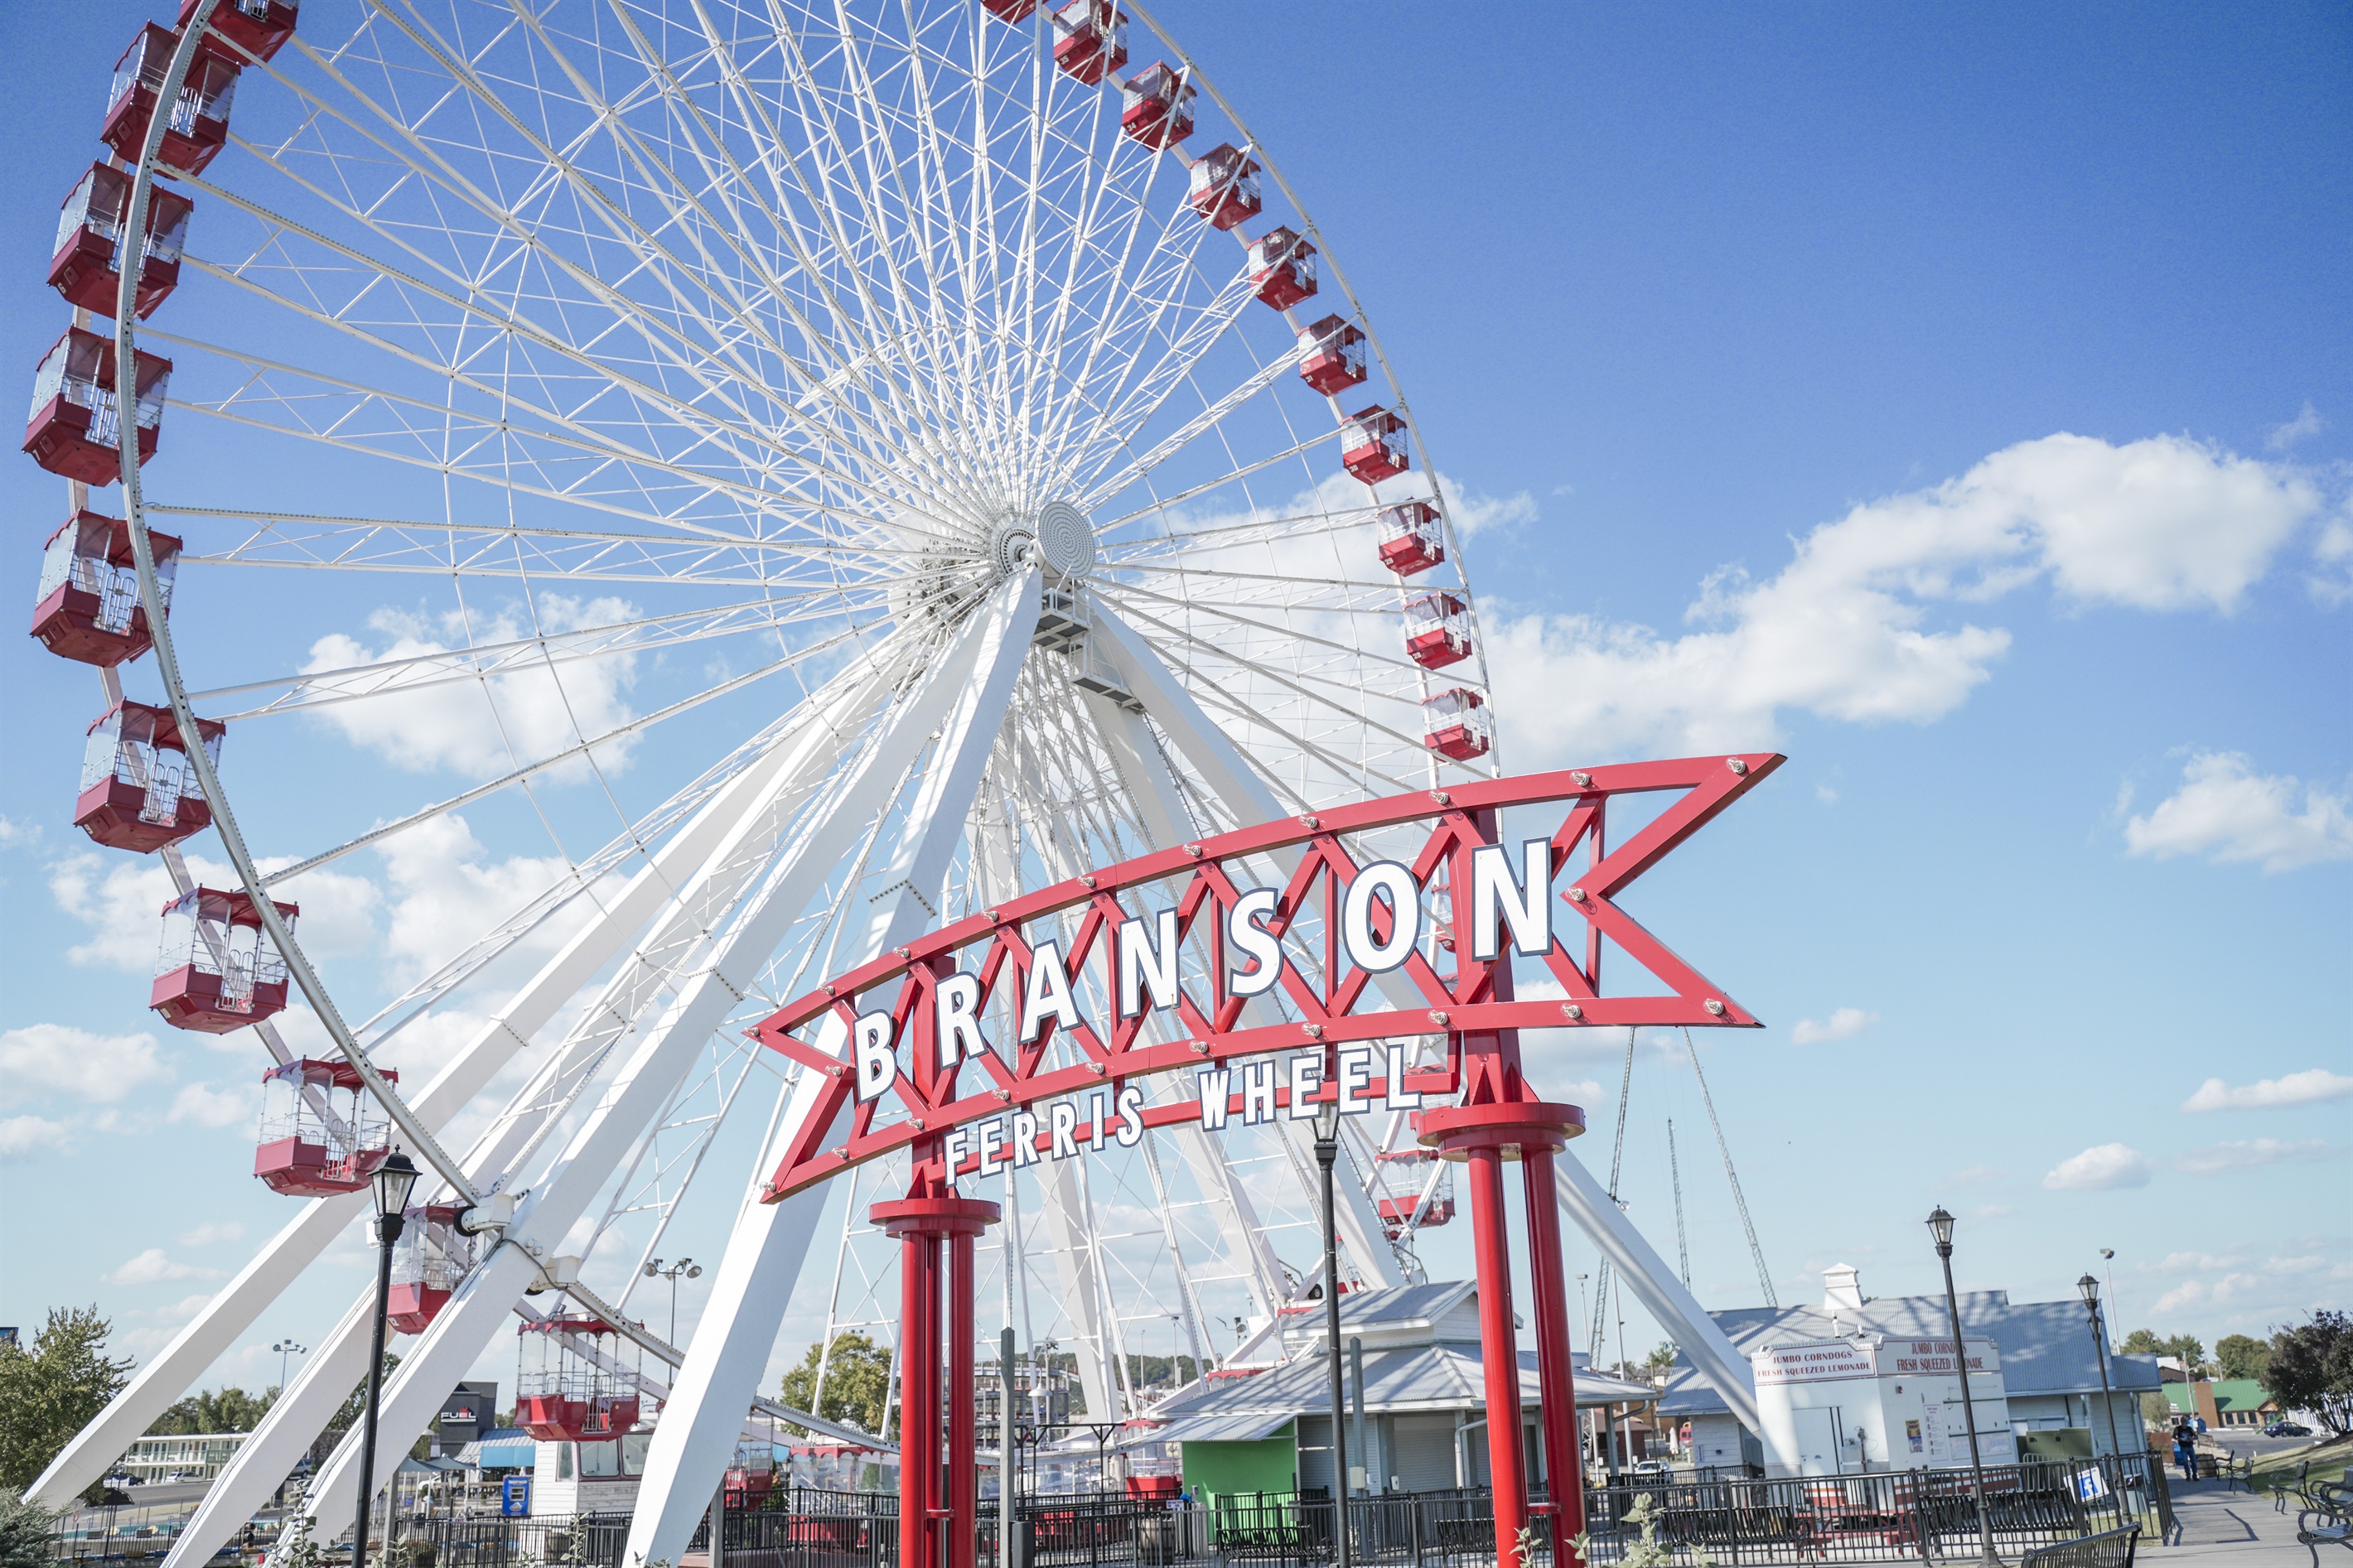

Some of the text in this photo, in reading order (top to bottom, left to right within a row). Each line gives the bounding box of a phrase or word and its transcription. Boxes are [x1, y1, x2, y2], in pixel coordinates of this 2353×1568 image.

[1127, 122, 1137, 132] 34
[109, 138, 119, 150] 5
[1305, 374, 1314, 383] 31
[32, 449, 41, 461] 7
[41, 634, 51, 646] 8
[853, 837, 1553, 1105] BRANSON
[944, 1044, 1423, 1189] FERRIS WHEEL
[1911, 1342, 1967, 1354] JUMBO CORNDS
[1772, 1351, 1853, 1364] JUMBO CORNDOGS
[1757, 1362, 1871, 1377] FRESH SQUEEZED LEMONADE
[1896, 1357, 1983, 1372] FRESH SQUEEZED LONADE
